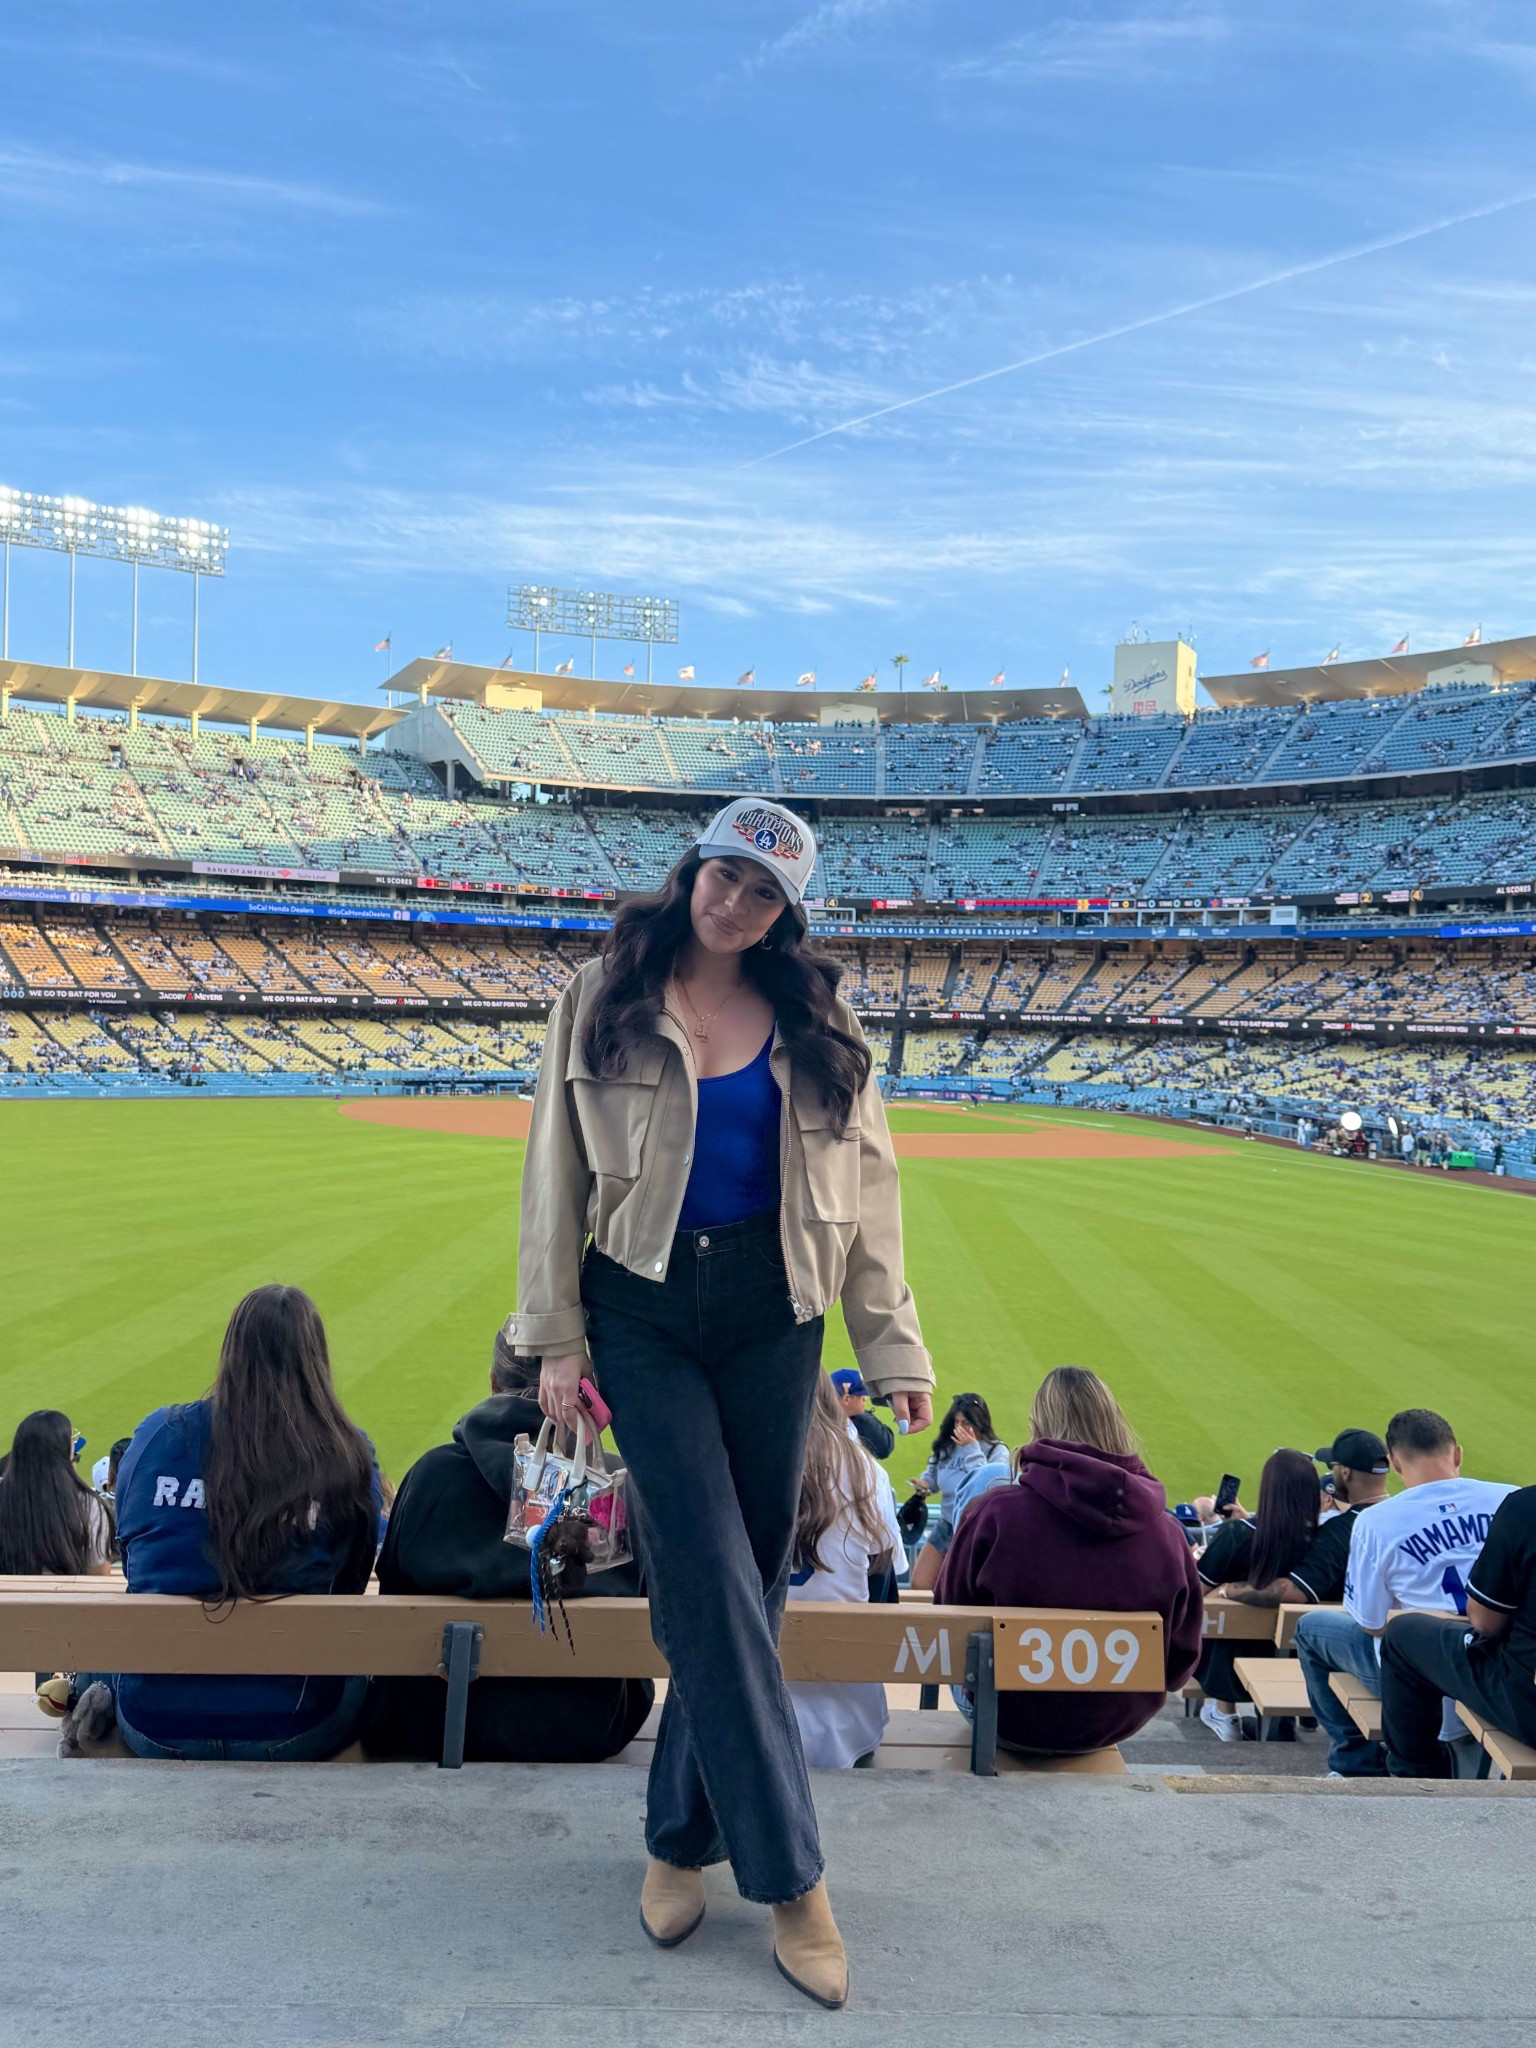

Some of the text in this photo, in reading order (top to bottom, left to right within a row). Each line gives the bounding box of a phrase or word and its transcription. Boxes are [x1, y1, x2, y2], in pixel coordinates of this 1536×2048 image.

[1123, 669, 1168, 694] Dodgers
[737, 810, 803, 854] CHAMPIONS
[758, 830, 772, 849] LA
[207, 866, 228, 874] BANK
[241, 868, 276, 877] AMERICA
[375, 876, 386, 884] NL
[387, 878, 413, 886] SCORES
[248, 903, 314, 914] SoCal Honda Dealers
[327, 908, 391, 919] @SoCalHondaDealers
[928, 927, 940, 935] AT
[987, 928, 1030, 936] STADIUM
[158, 991, 187, 1000] JACOBY
[194, 992, 223, 1001] MEYERS
[373, 996, 397, 1005] JACOBY
[403, 998, 429, 1006] MEYERS
[929, 1011, 953, 1019] JACOBY
[959, 1012, 985, 1020] MEYERS
[1399, 1513, 1495, 1566] YAMAMO
[1201, 1610, 1226, 1635] H
[893, 1626, 952, 1676] M
[1018, 1627, 1140, 1684] 309
